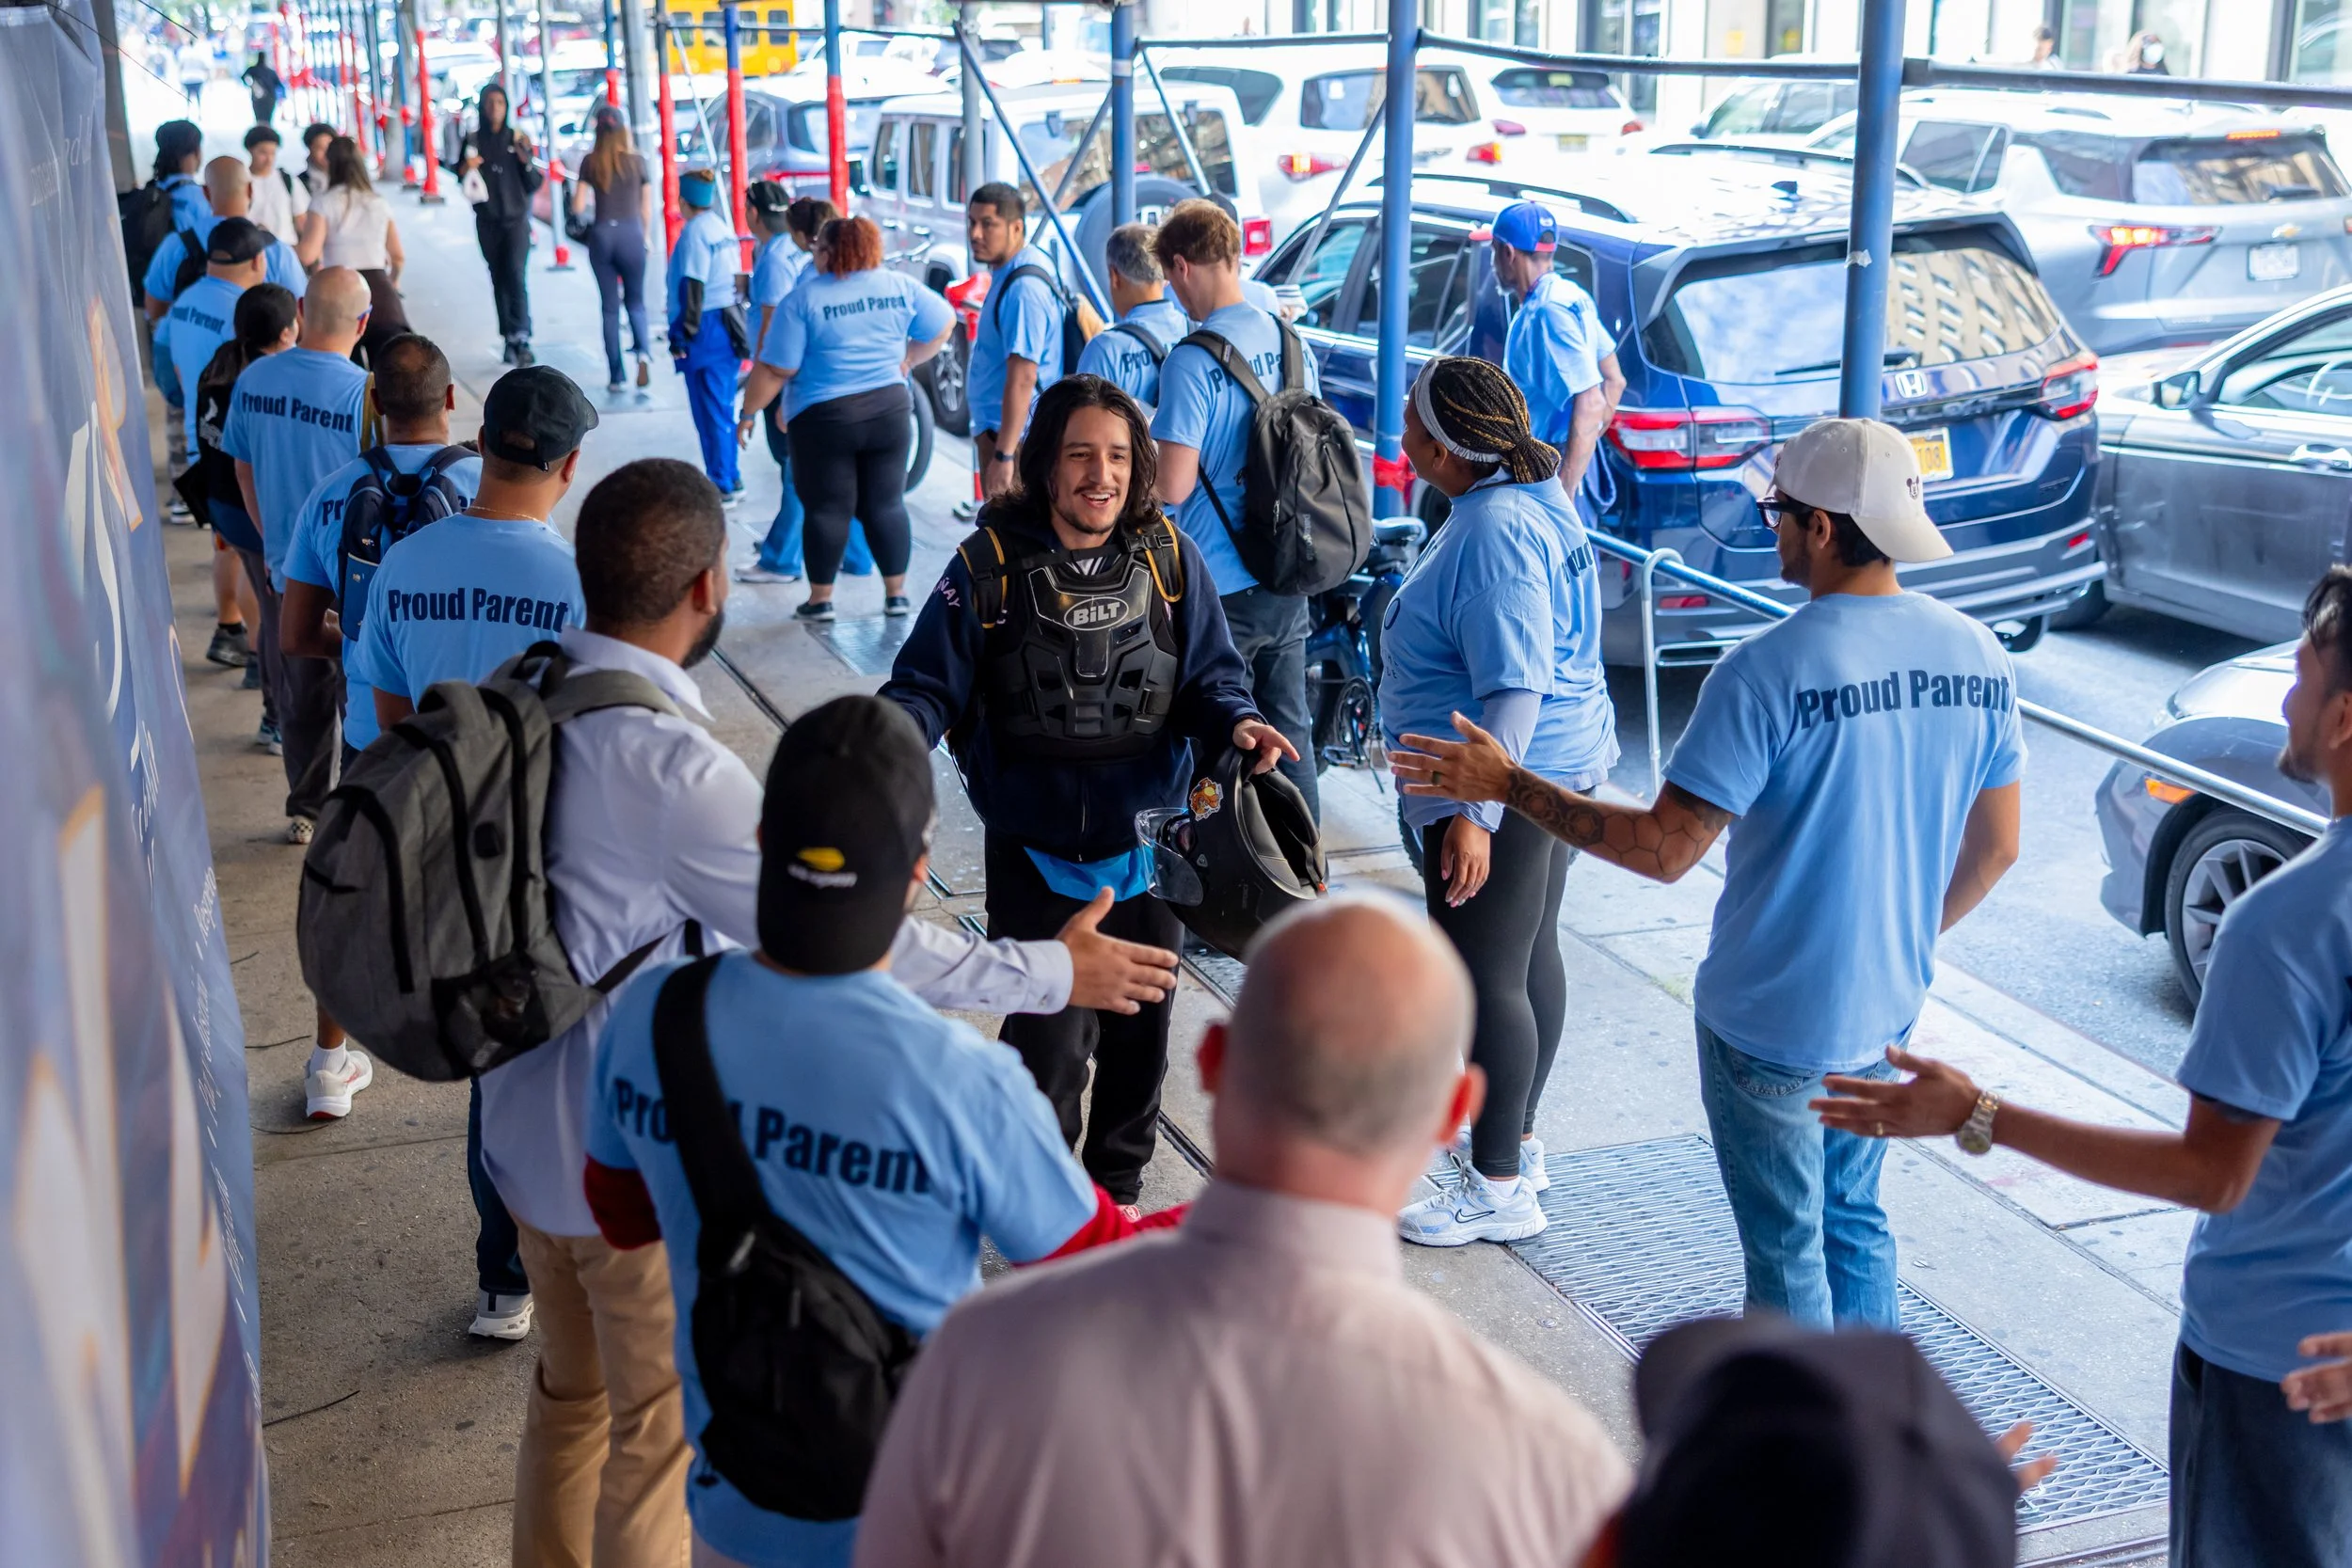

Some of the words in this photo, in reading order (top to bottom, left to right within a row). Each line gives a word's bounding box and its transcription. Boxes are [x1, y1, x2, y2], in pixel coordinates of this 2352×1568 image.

[822, 297, 866, 321] Proud
[866, 295, 907, 311] Pare
[1120, 350, 1151, 373] Pro
[291, 398, 354, 434] Parent
[388, 587, 466, 622] Proud
[472, 587, 569, 633] Parent
[1796, 671, 1901, 731] Proud
[1908, 669, 2010, 713] Parent
[613, 1078, 743, 1144] Pro
[755, 1105, 930, 1195] Parent
